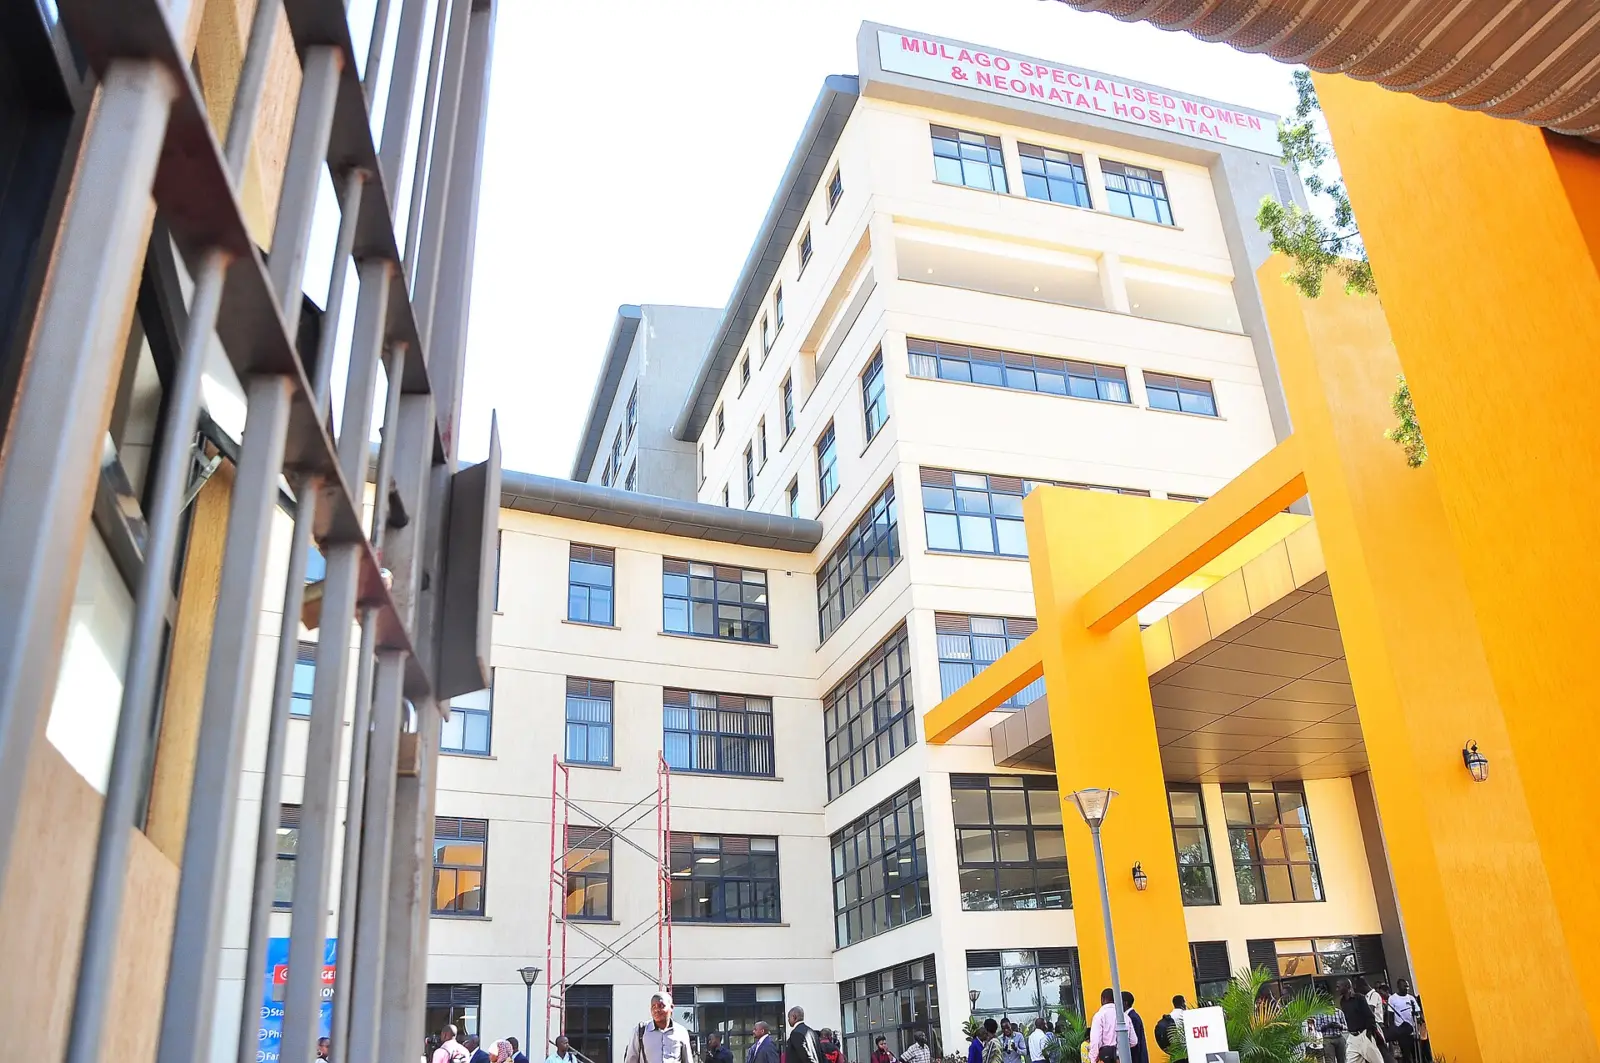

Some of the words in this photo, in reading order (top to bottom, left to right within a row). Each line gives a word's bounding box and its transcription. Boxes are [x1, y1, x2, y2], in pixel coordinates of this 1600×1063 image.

[901, 36, 1011, 71] MULAGO
[1019, 62, 1176, 109] SPECIALISED
[1181, 100, 1262, 130] WOMEN
[951, 66, 969, 80] &
[976, 71, 1106, 112] NEONATAL
[1113, 101, 1228, 140] HOSPITAL
[1192, 1026, 1209, 1039] EXIT
